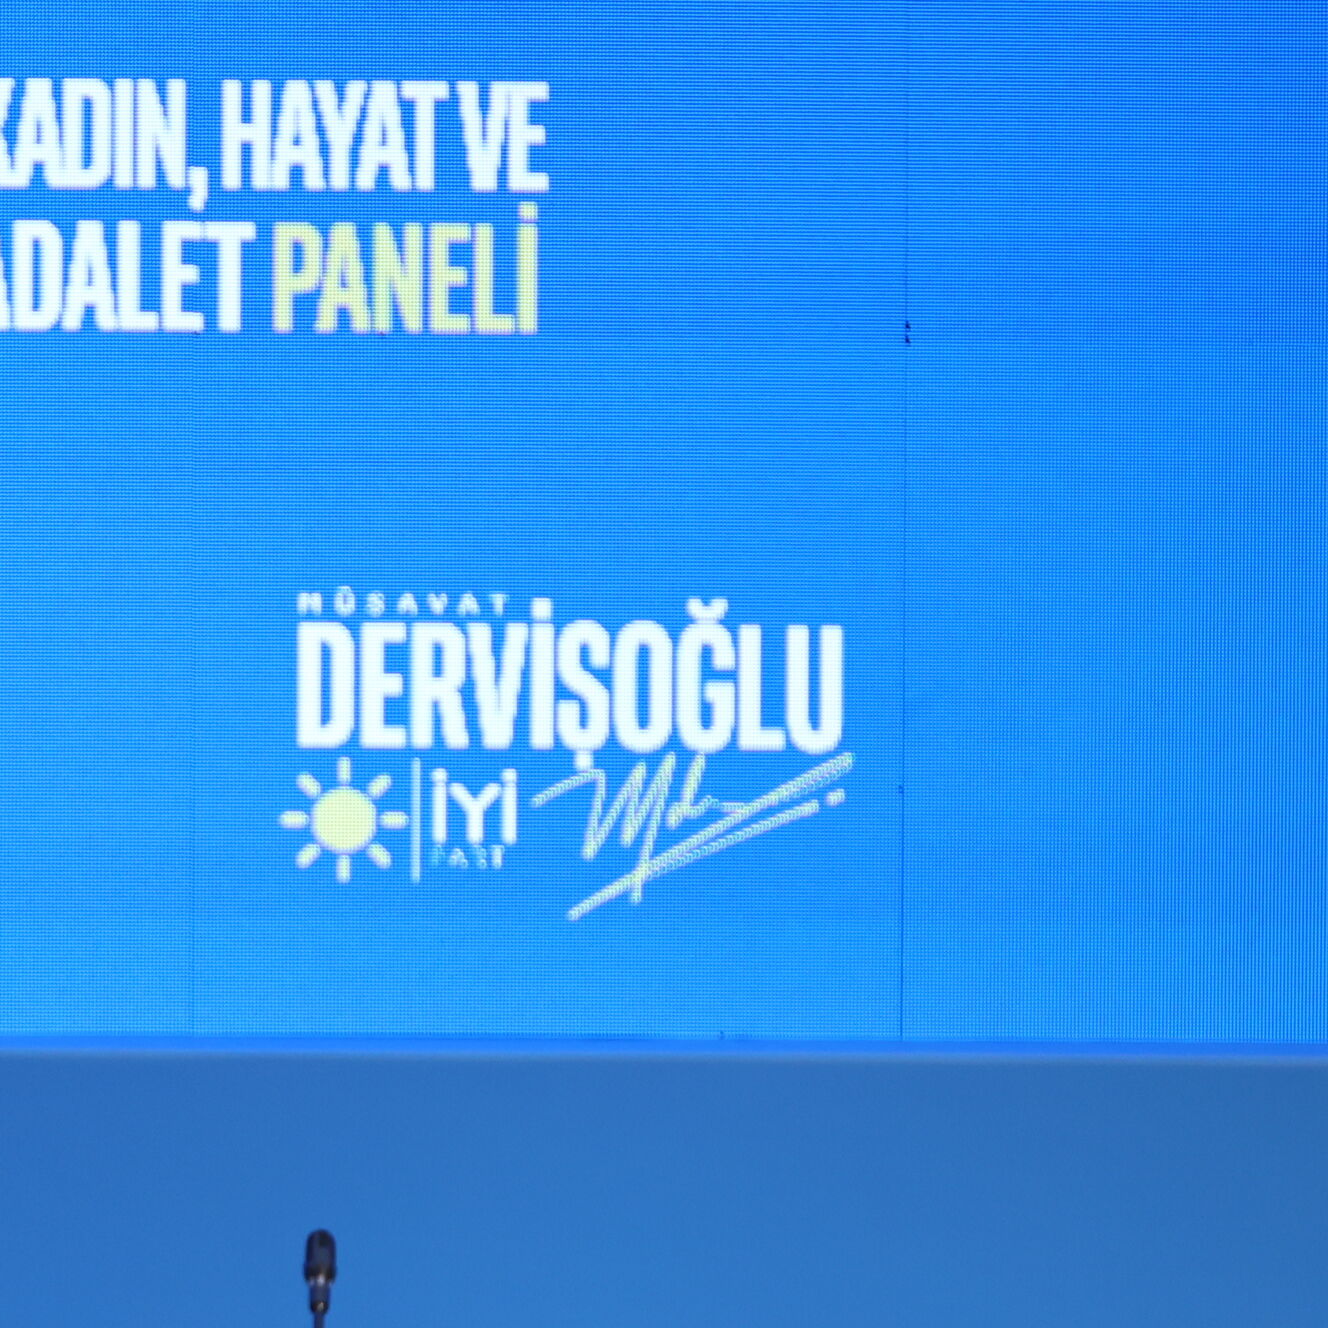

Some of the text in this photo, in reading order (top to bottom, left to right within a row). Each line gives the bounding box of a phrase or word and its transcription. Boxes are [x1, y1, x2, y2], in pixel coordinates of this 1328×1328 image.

[221, 79, 449, 191] HAYAT
[456, 80, 550, 192] VE
[272, 202, 538, 334] PANELİ
[296, 597, 843, 771] DERVİŞOĞLU
[431, 768, 517, 845] İYİ
